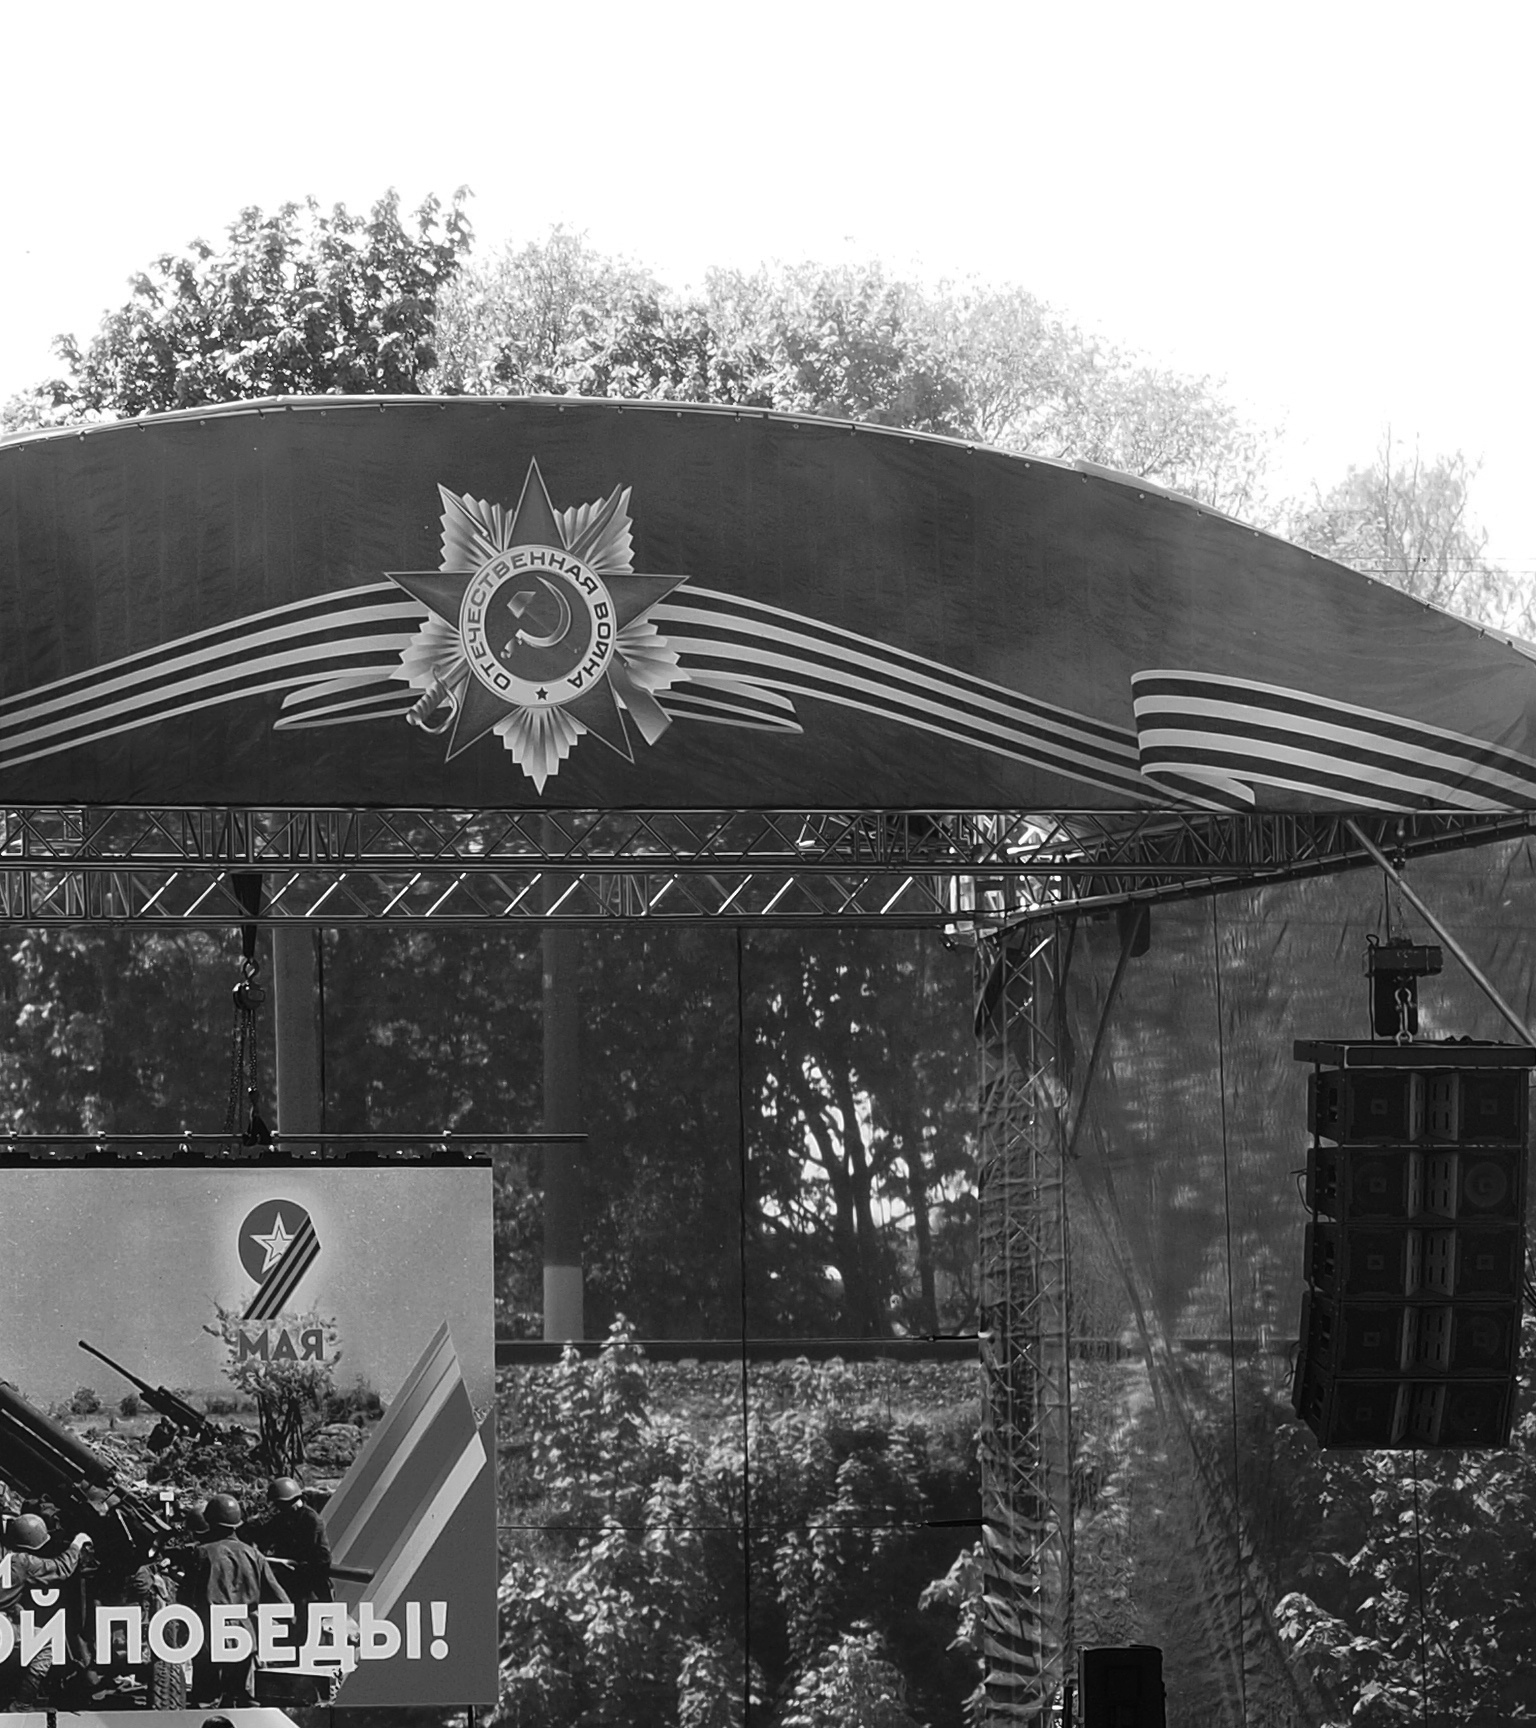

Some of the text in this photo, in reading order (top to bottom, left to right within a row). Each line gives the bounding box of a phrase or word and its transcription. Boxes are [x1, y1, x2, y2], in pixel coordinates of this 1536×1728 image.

[467, 550, 599, 691] ОТЕЧЕСТВЕННАЯ
[238, 1328, 324, 1362] МАЯ
[95, 1600, 450, 1672] ПОБЕДЫ!
